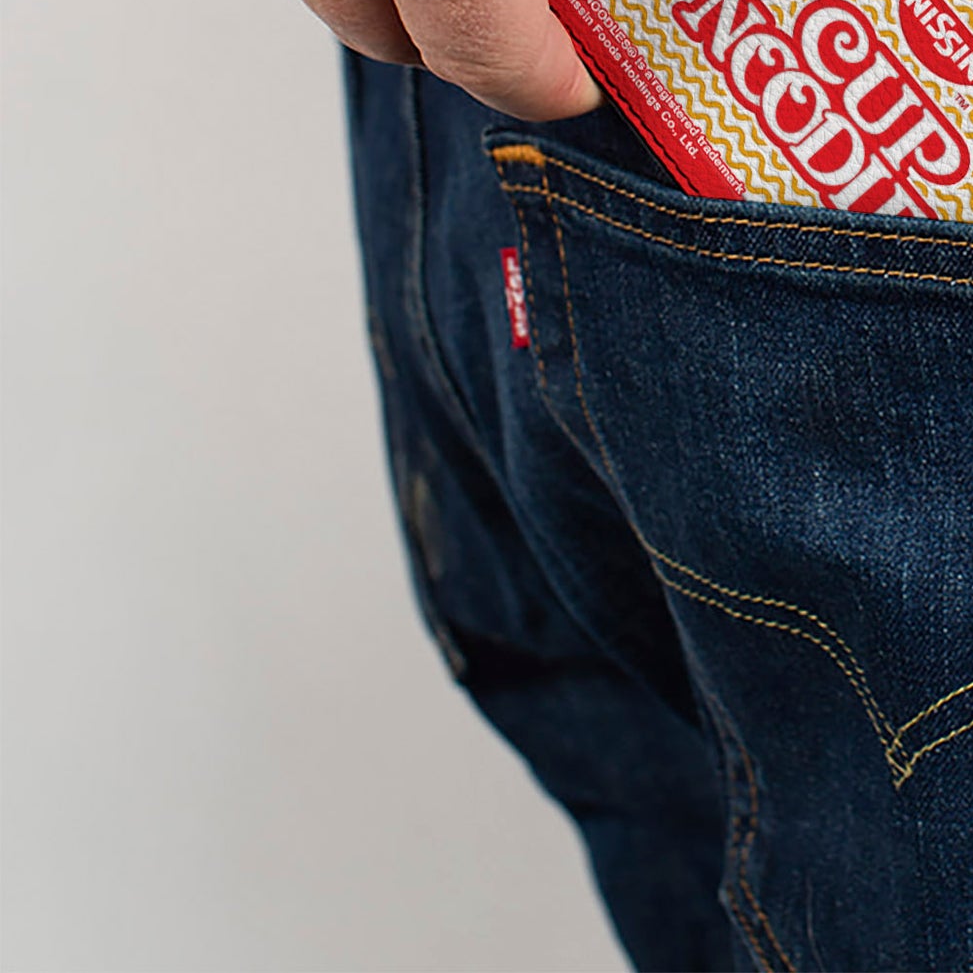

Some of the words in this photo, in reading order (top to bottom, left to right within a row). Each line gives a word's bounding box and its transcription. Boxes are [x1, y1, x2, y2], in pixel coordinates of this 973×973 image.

[592, 24, 622, 61] Foods
[621, 59, 661, 111] Holdings
[661, 111, 677, 137] Co.,
[679, 134, 699, 159] Ltd.
[635, 56, 646, 70] is
[644, 70, 652, 81] a
[651, 77, 700, 137] registered
[697, 135, 744, 195] trademark
[800, 4, 964, 180] CUP
